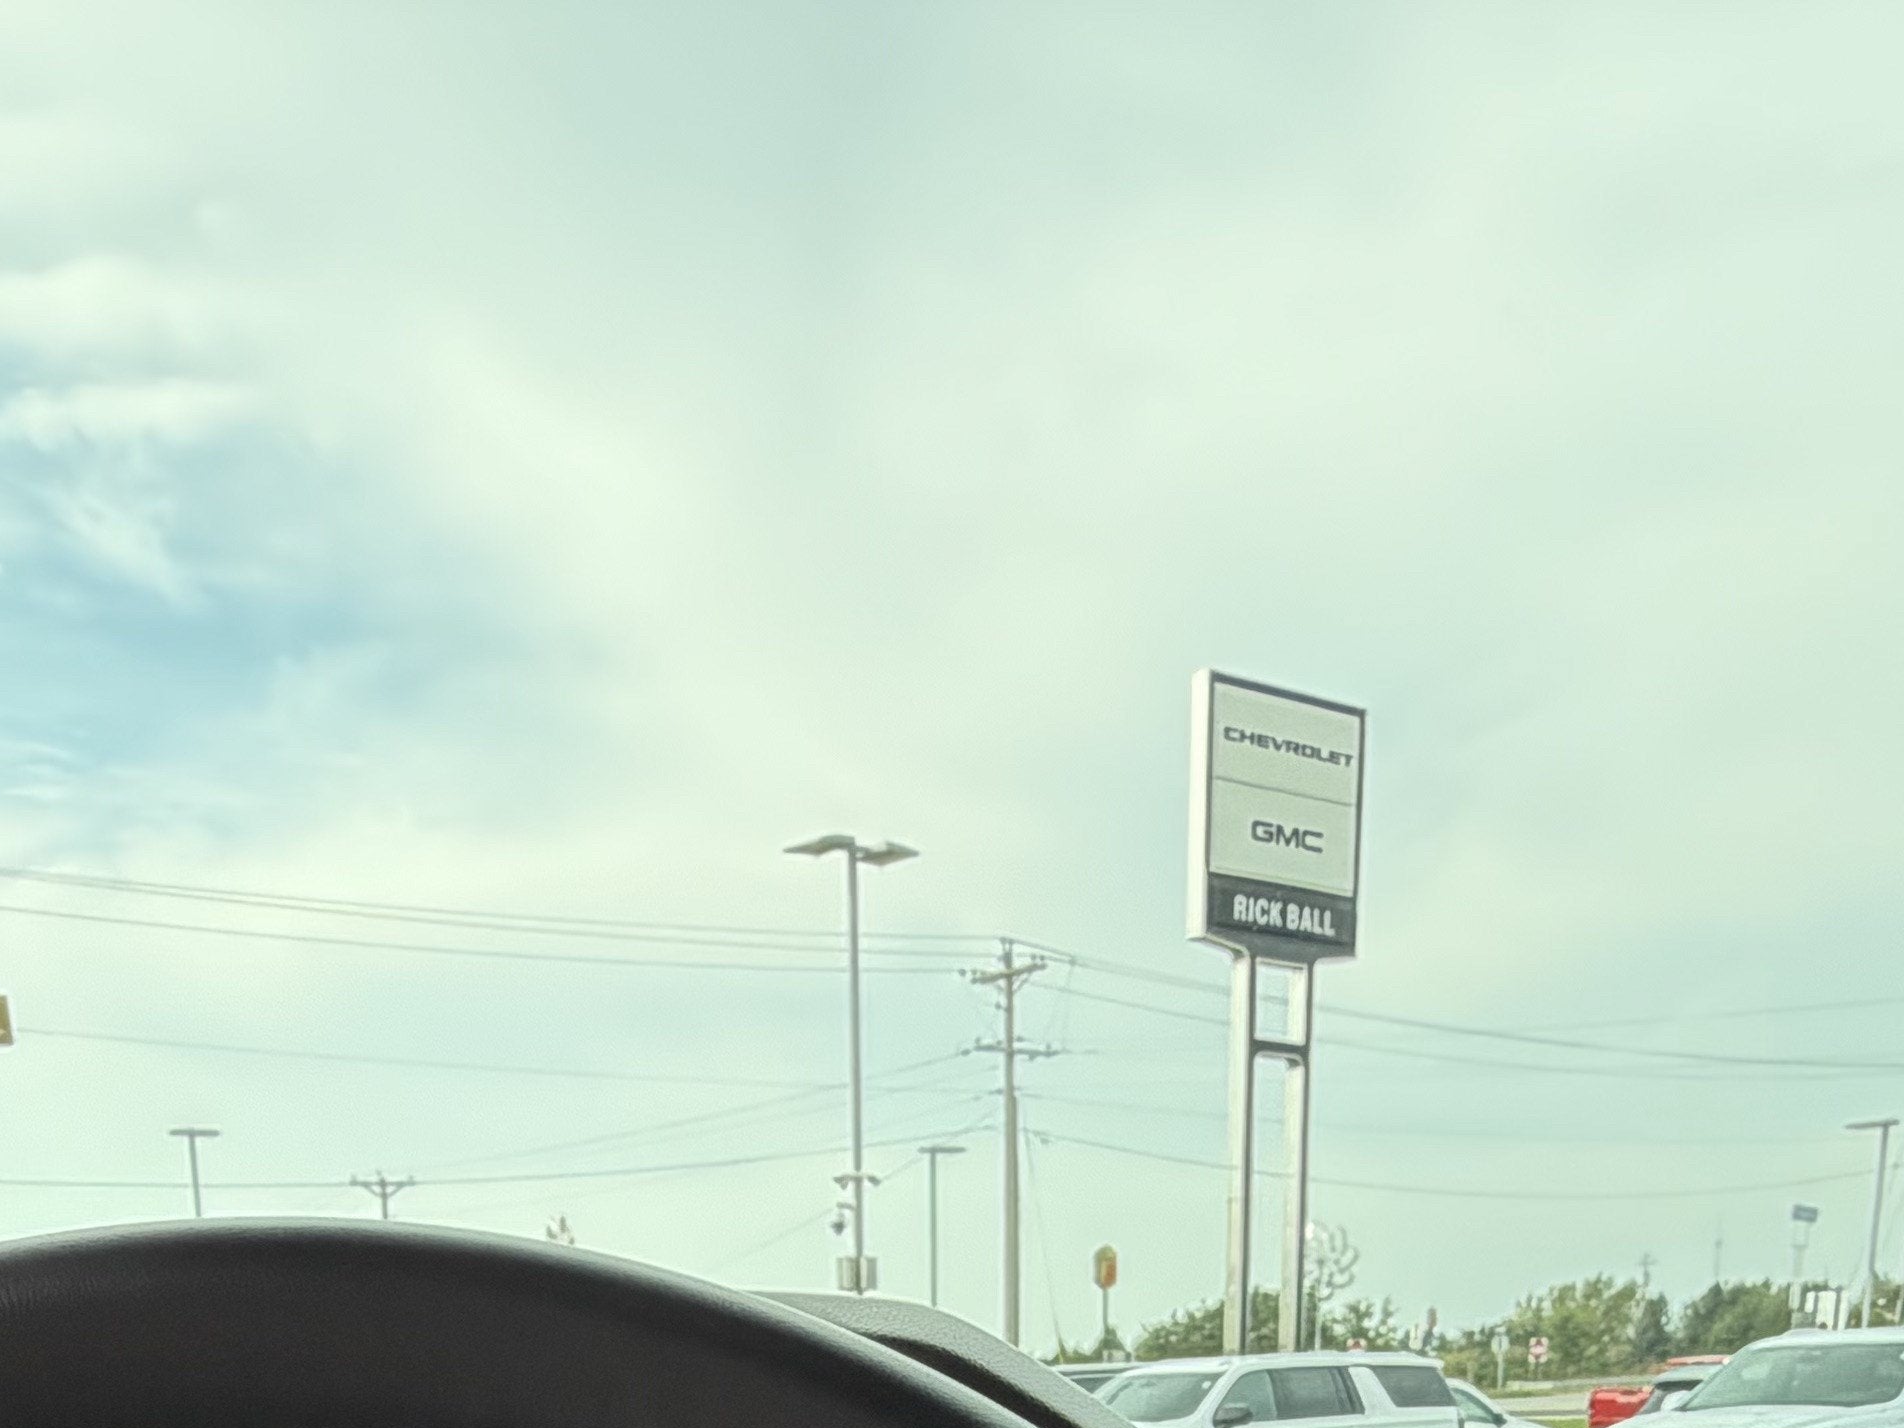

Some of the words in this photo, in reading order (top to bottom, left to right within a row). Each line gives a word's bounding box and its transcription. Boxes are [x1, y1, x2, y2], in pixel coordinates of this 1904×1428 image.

[1222, 725, 1355, 768] CHEVROLET
[1250, 819, 1326, 855] GMC
[1232, 893, 1284, 929] RICK
[1285, 903, 1338, 939] BALL
